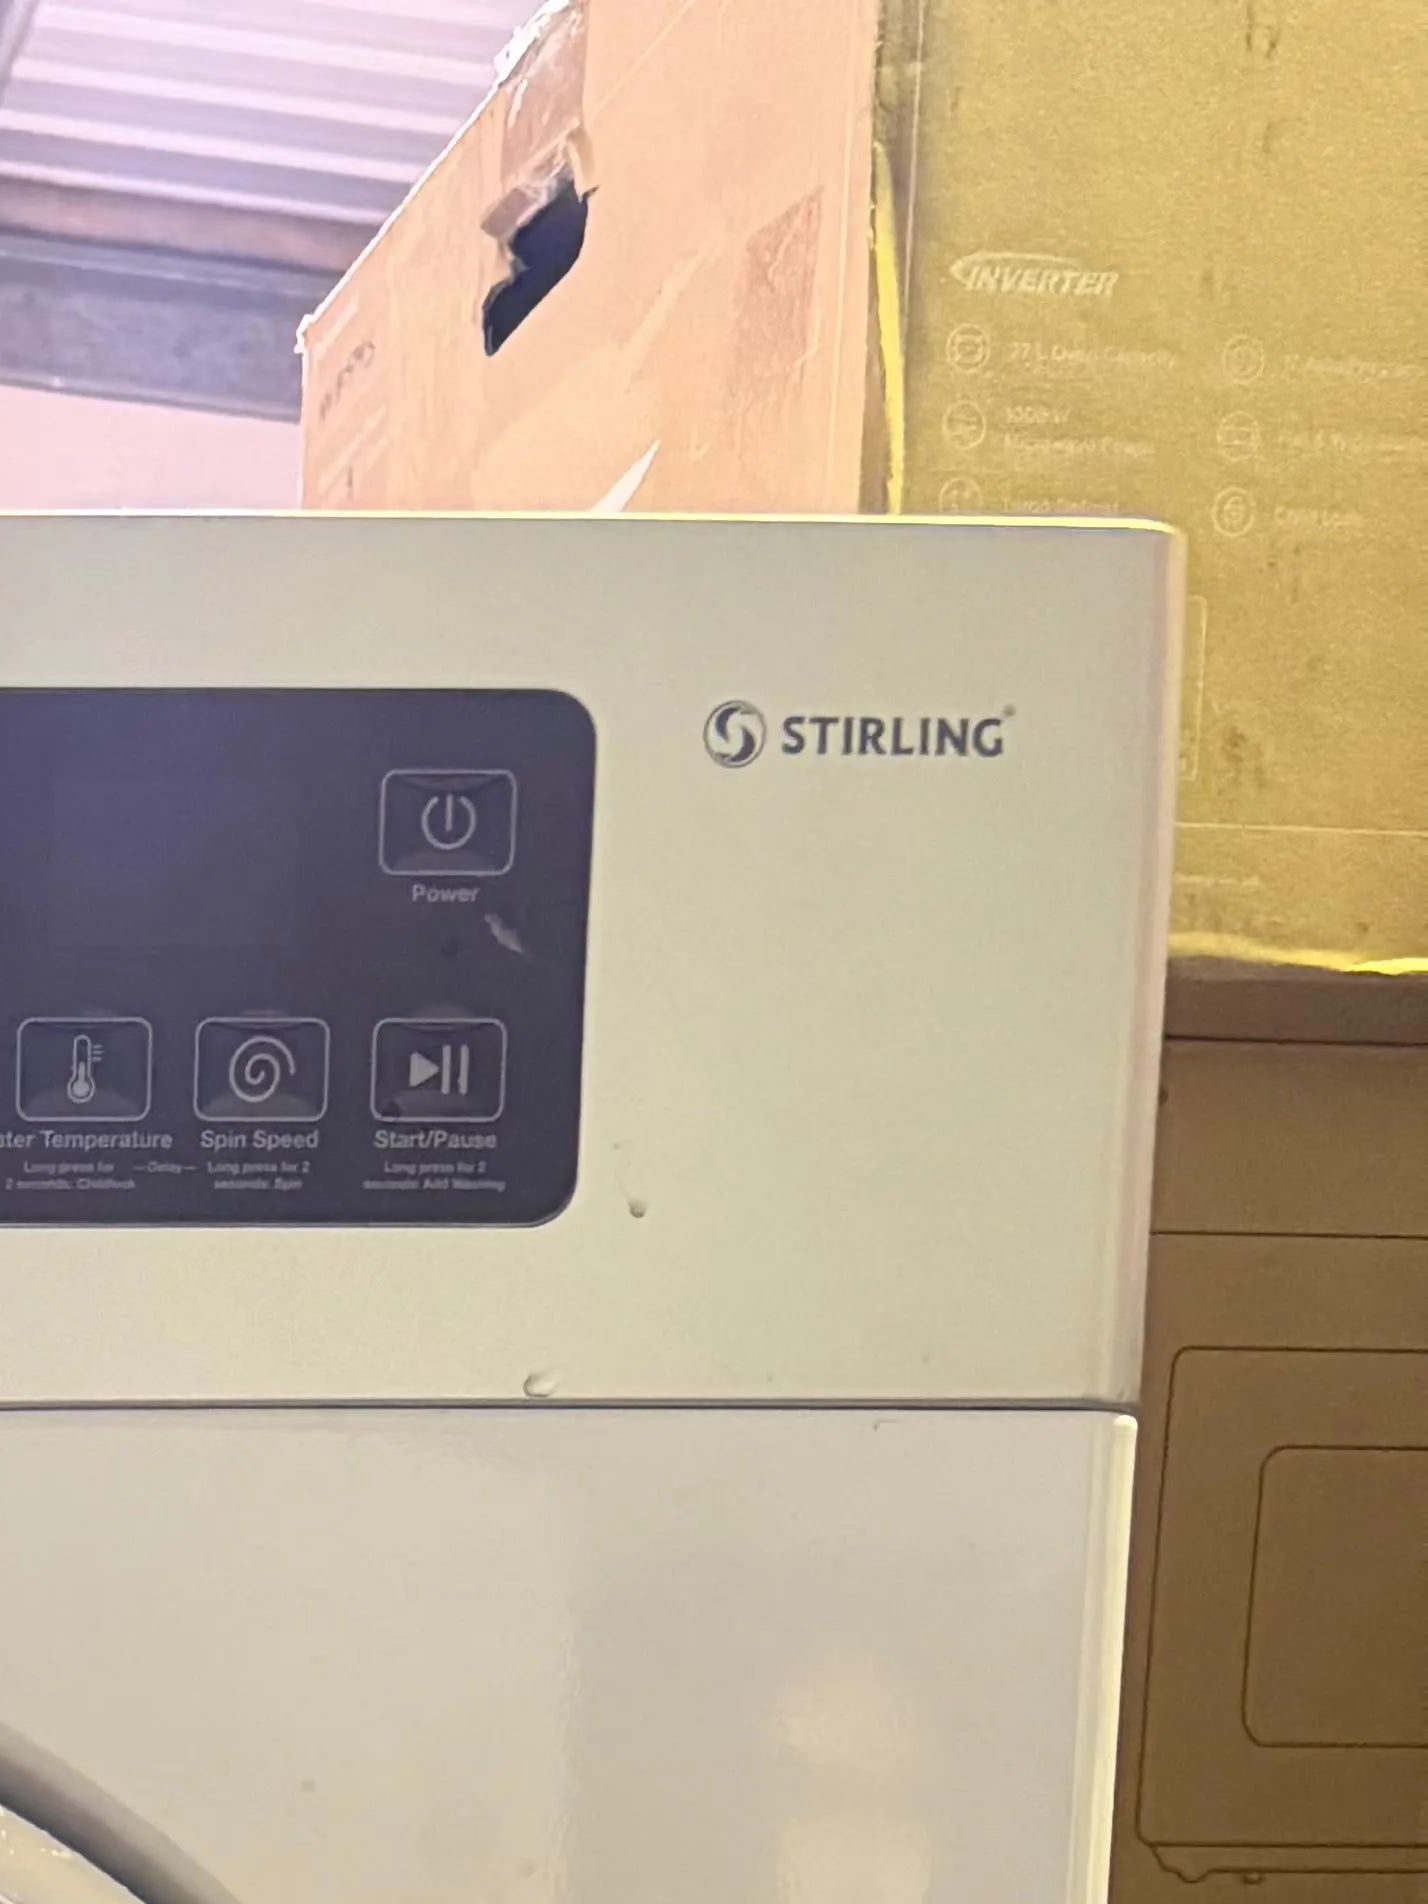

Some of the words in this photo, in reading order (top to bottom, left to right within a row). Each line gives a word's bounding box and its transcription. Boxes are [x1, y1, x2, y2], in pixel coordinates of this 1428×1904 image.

[963, 264, 1118, 295] INVERTER
[781, 715, 1004, 757] STIRLING
[411, 884, 480, 903] Power
[40, 1131, 173, 1152] Temperature
[200, 1130, 246, 1151] Spin
[252, 1130, 320, 1151] Speed
[374, 1130, 497, 1149] Start/Pause
